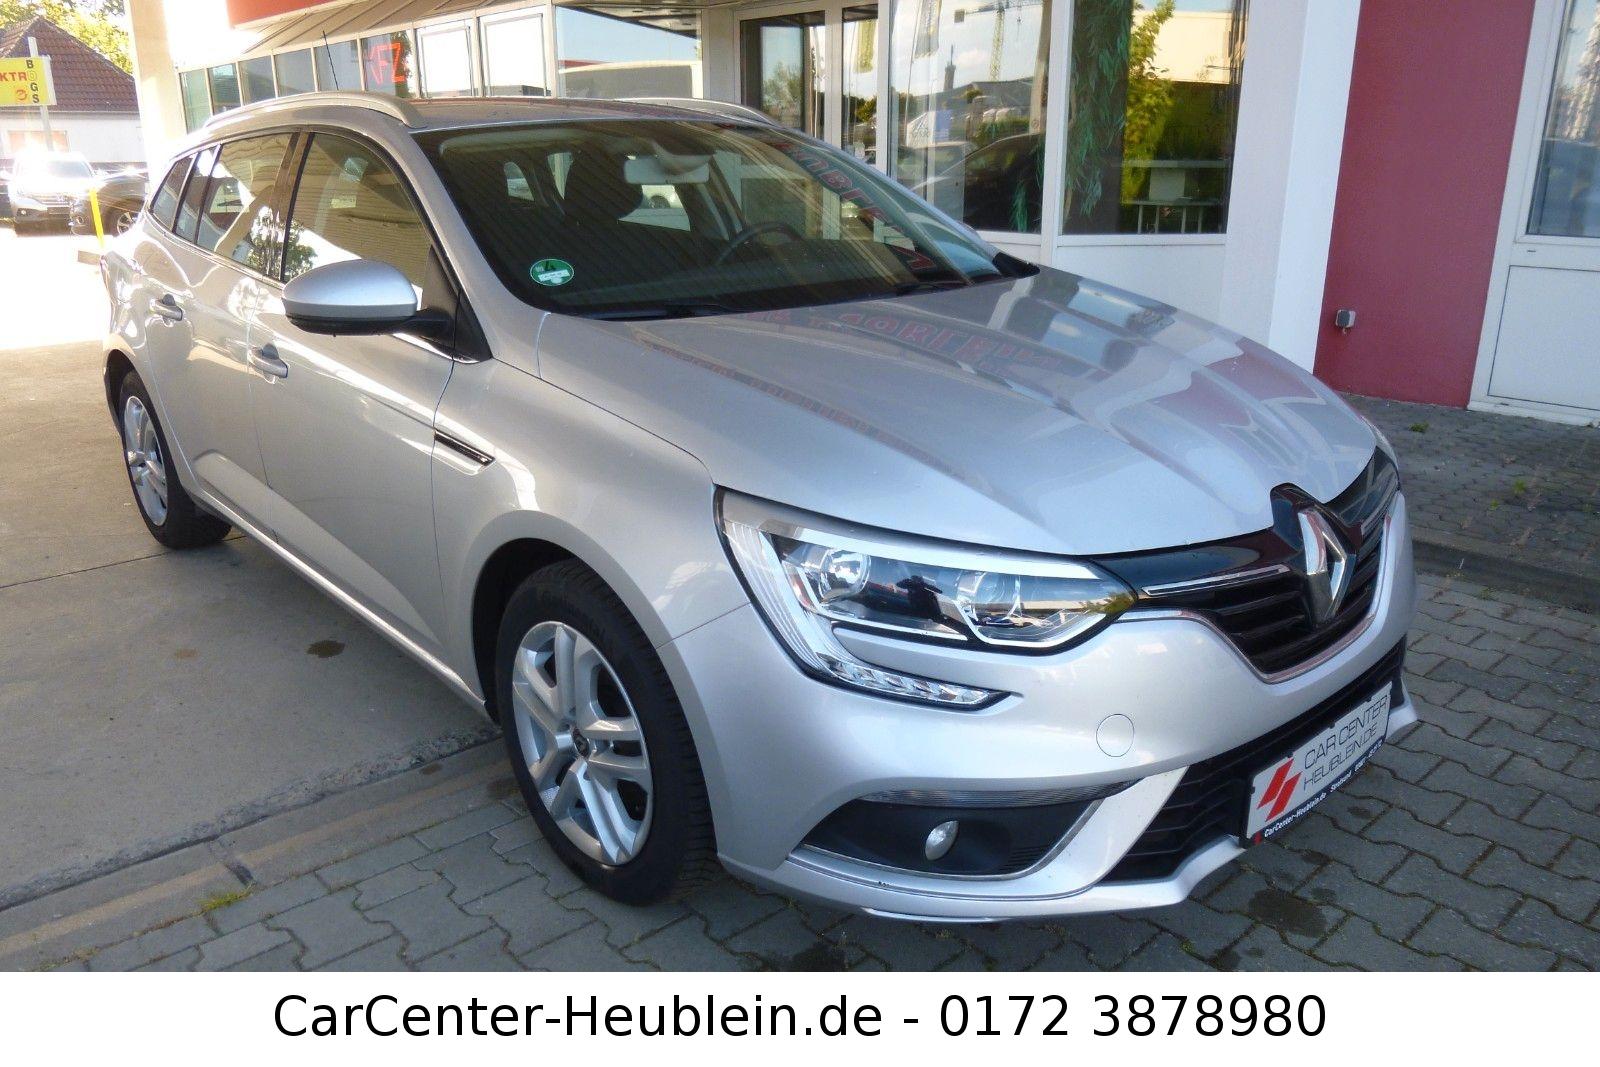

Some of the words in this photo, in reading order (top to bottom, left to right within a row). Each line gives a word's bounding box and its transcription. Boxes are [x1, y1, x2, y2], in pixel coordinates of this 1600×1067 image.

[1303, 722, 1378, 791] HEUBLEIN.DE
[1304, 734, 1337, 770] CAR
[1338, 694, 1388, 746] CENTER
